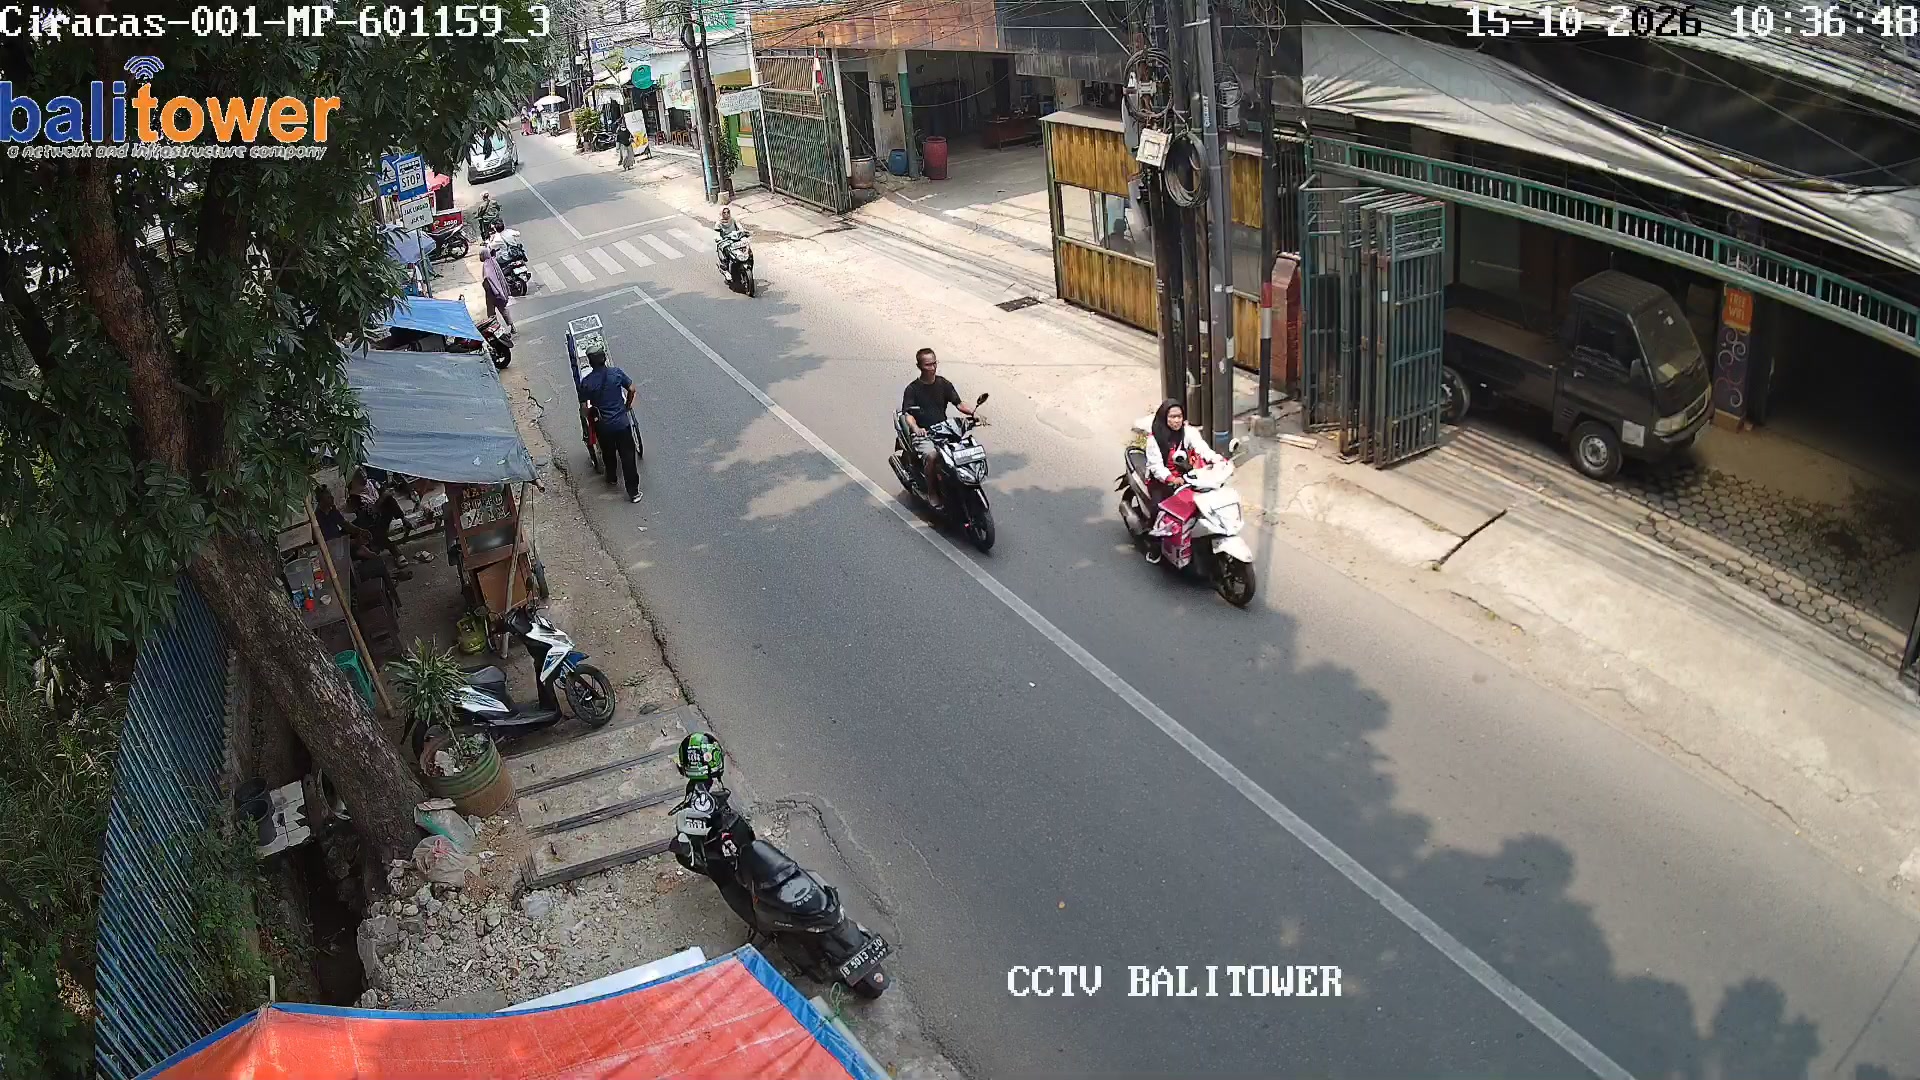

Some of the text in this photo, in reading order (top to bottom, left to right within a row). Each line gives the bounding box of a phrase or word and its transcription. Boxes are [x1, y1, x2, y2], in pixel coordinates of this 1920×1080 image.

[401, 173, 421, 188] STOP
[1729, 293, 1747, 307] FREE
[842, 966, 851, 976] B
[850, 951, 869, 969] 5013
